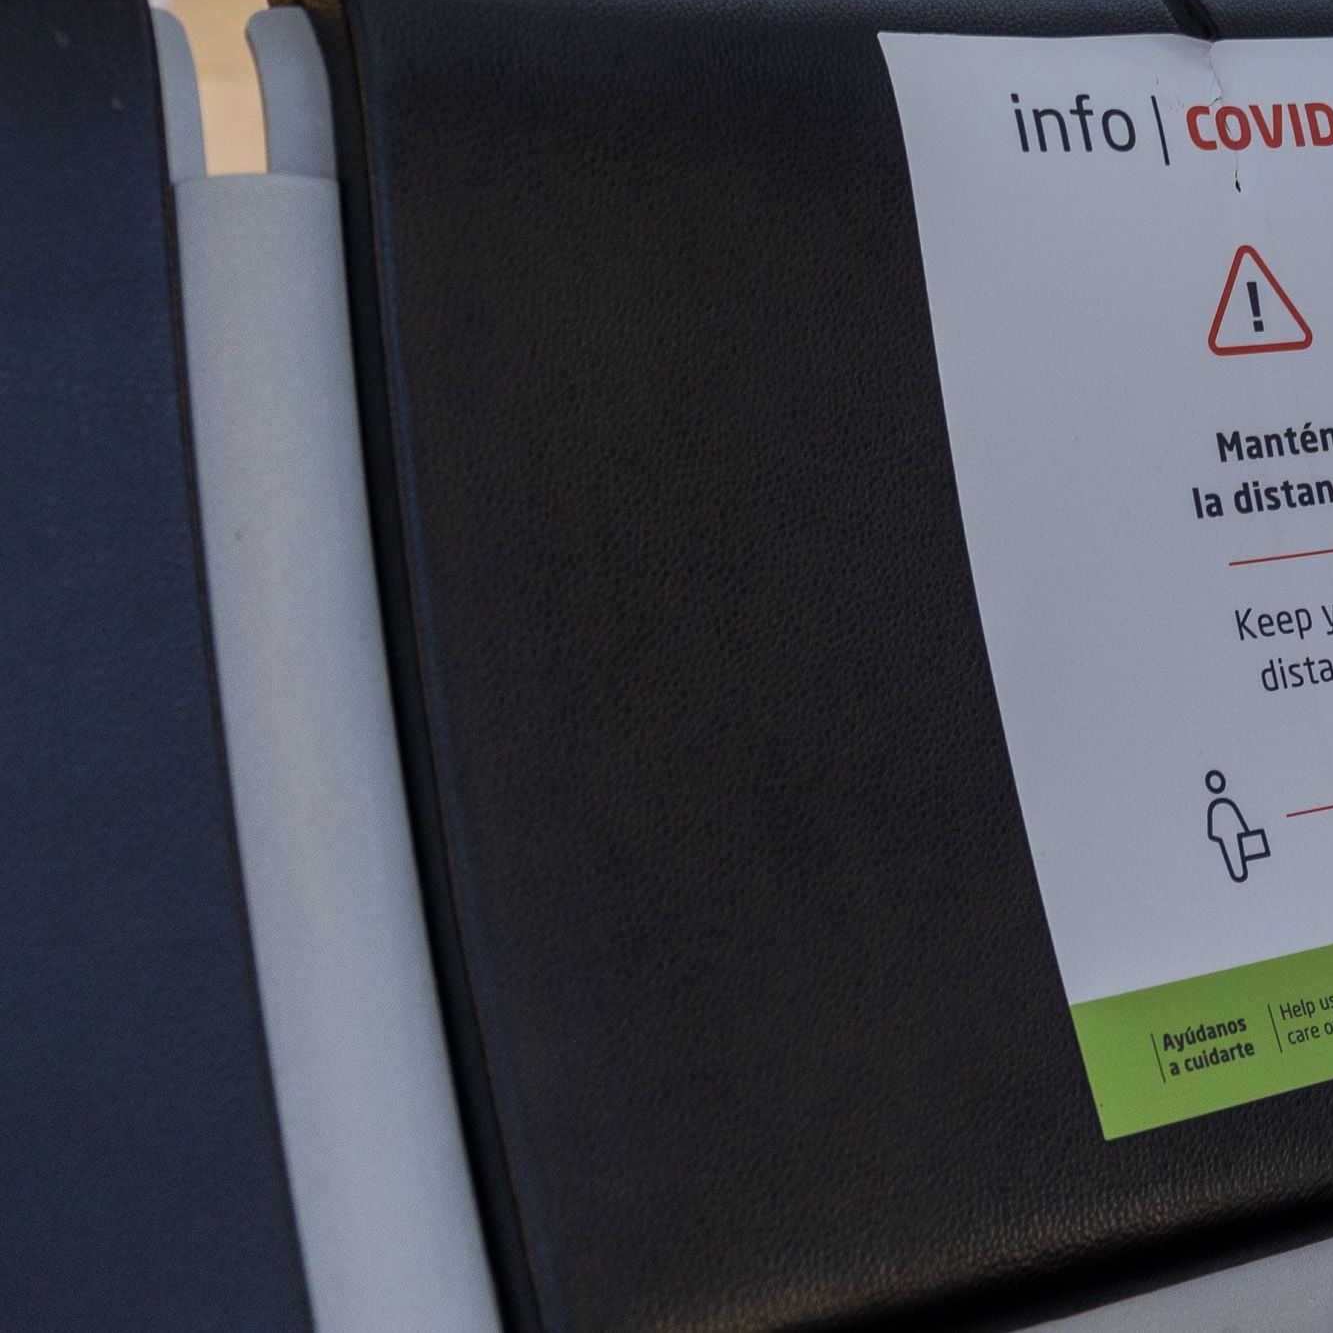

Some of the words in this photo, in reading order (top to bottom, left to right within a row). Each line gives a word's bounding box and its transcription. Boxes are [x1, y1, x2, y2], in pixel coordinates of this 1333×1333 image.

[1011, 93, 1136, 154] info
[1191, 486, 1224, 520] la
[1235, 606, 1313, 642] Keep
[1279, 999, 1317, 1022] Help
[1162, 1017, 1248, 1053] Ayúdanos
[1287, 1026, 1321, 1046] care
[1169, 1061, 1182, 1077] a
[1184, 1042, 1256, 1074] cuidarte
